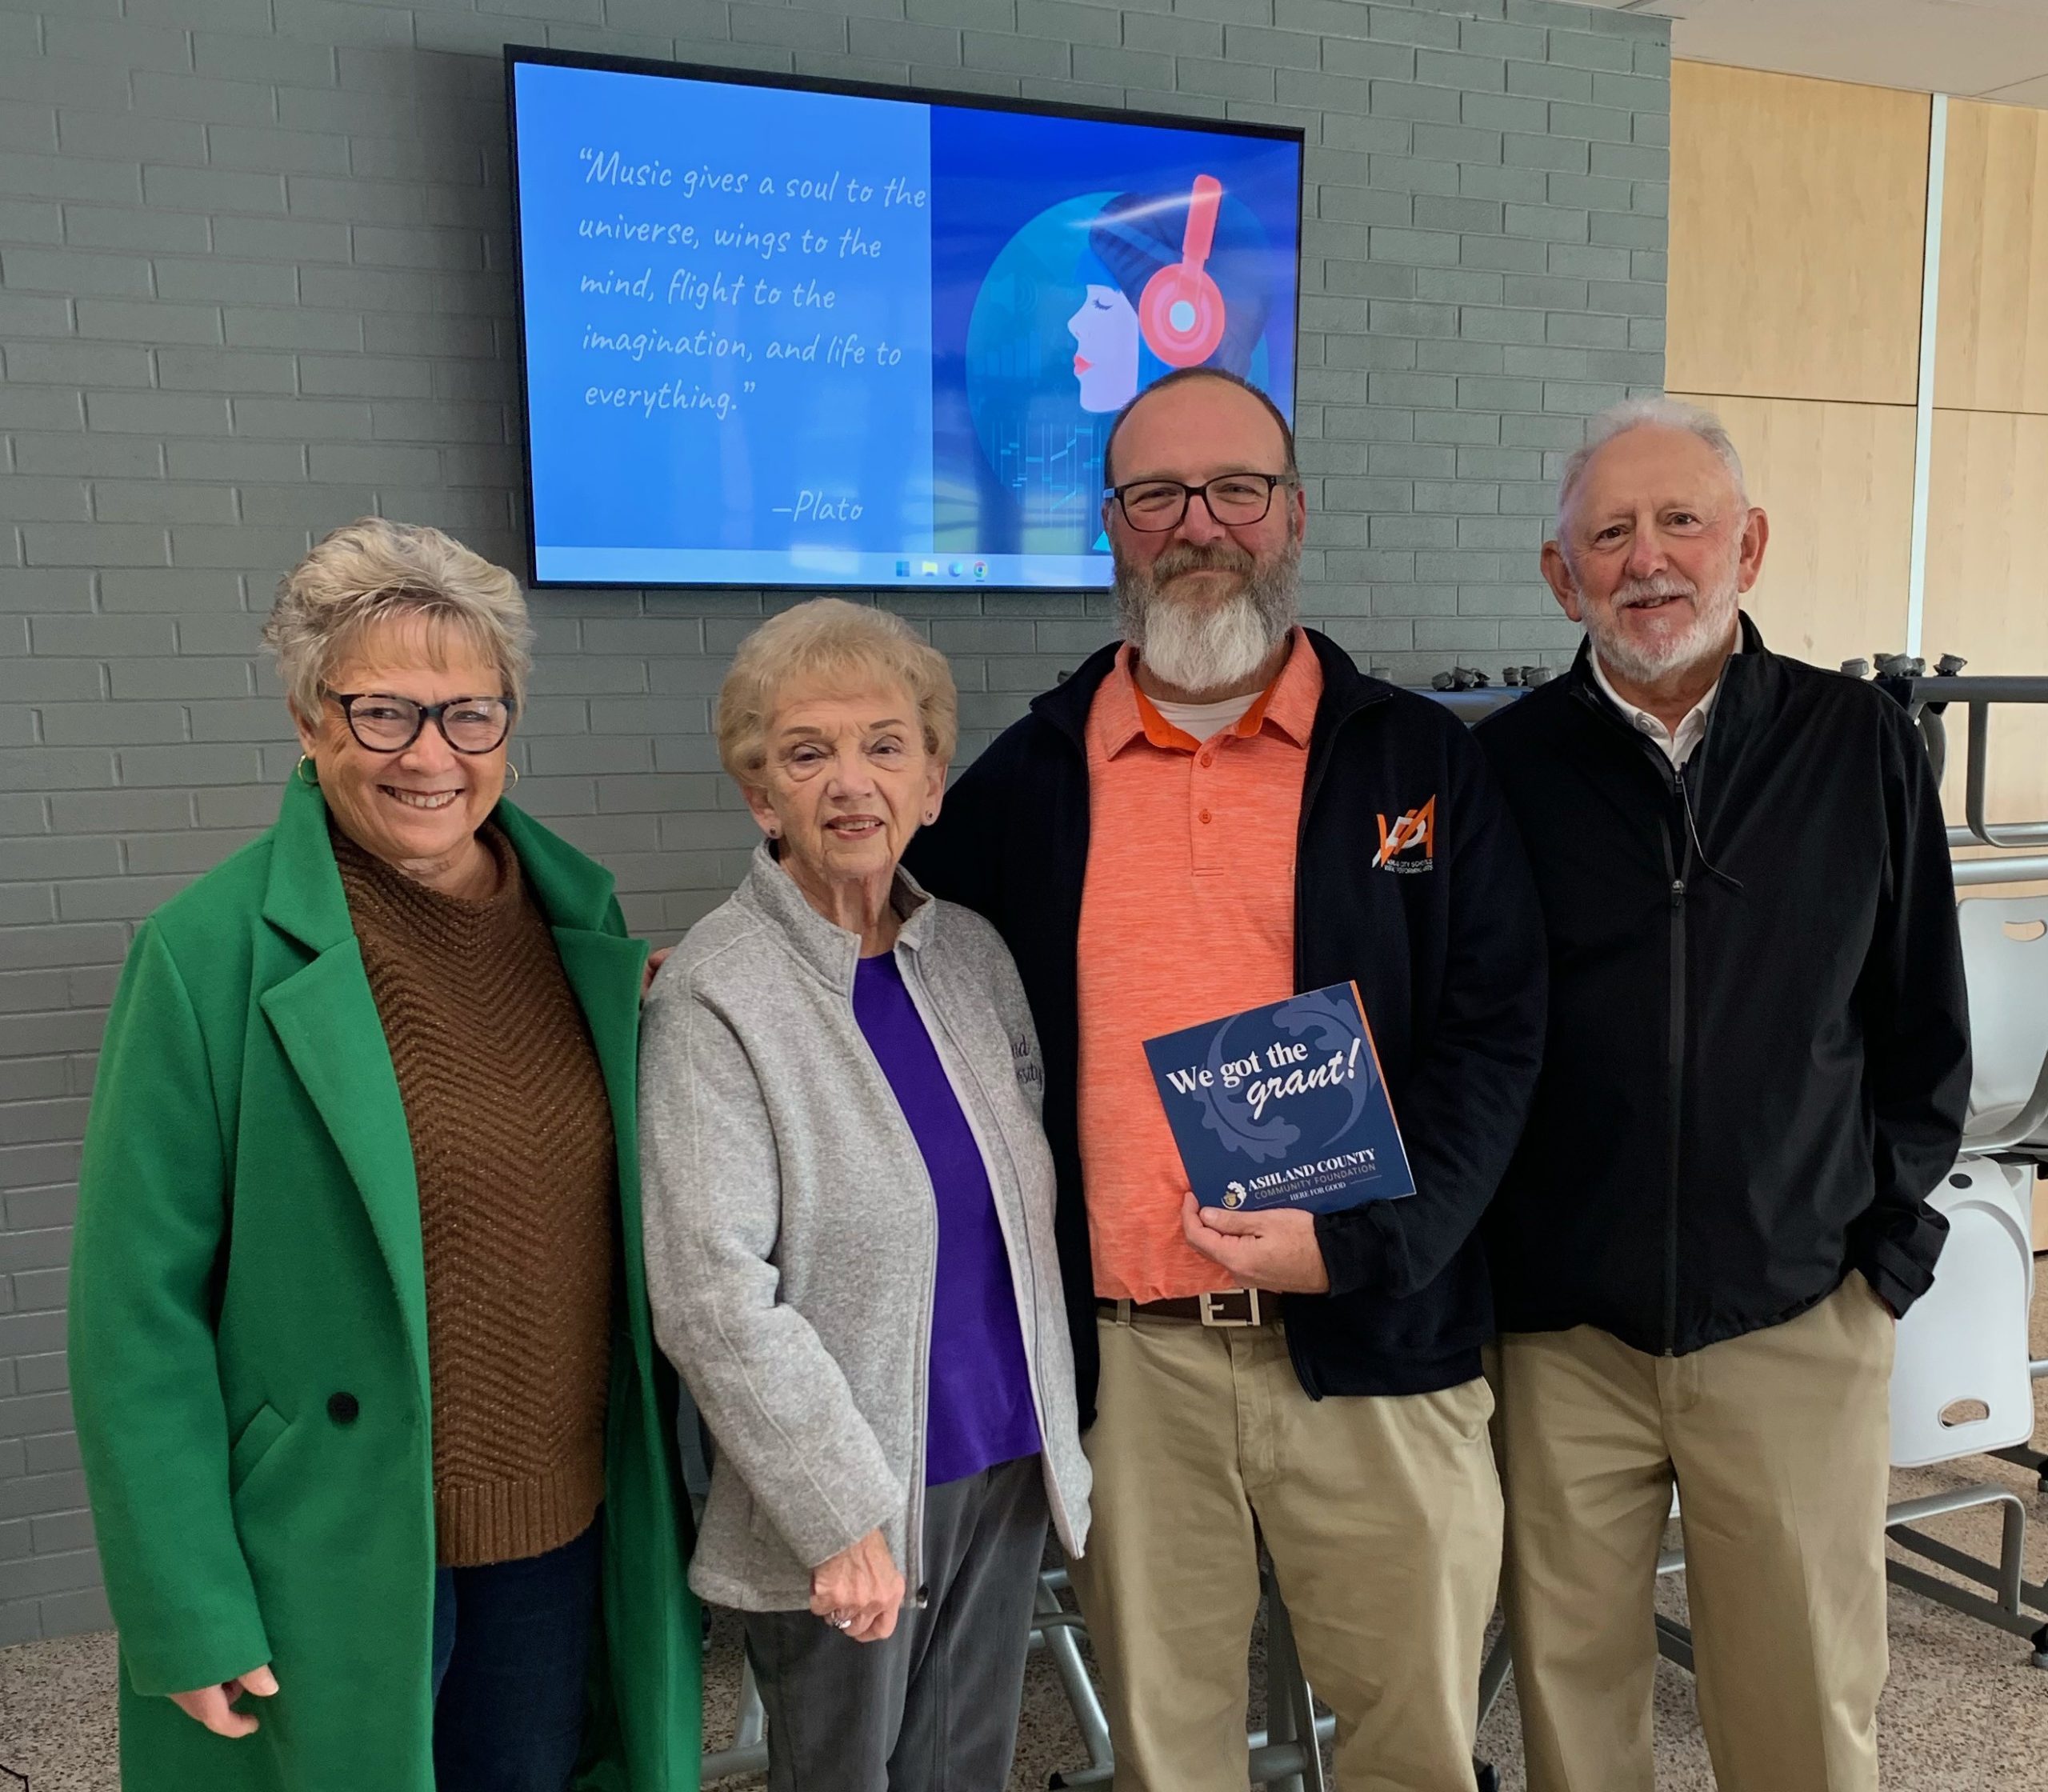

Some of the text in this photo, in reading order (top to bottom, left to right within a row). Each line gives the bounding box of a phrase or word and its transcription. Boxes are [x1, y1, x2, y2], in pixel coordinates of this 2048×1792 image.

[579, 147, 926, 208] “Music gives a soul to the
[579, 214, 882, 259] universe, wings to the
[581, 268, 836, 310] mind, flight to the
[582, 324, 902, 368] imagination, and life to
[585, 379, 756, 420] everything.”
[1166, 1041, 1308, 1094] We got the
[1246, 1038, 1361, 1120] grant!
[1249, 1148, 1376, 1191] ASHLAND COUNTY
[1254, 1163, 1376, 1200] COMMUNITY FOUNDATION
[1290, 1182, 1346, 1201] HERE FOR GOOD
